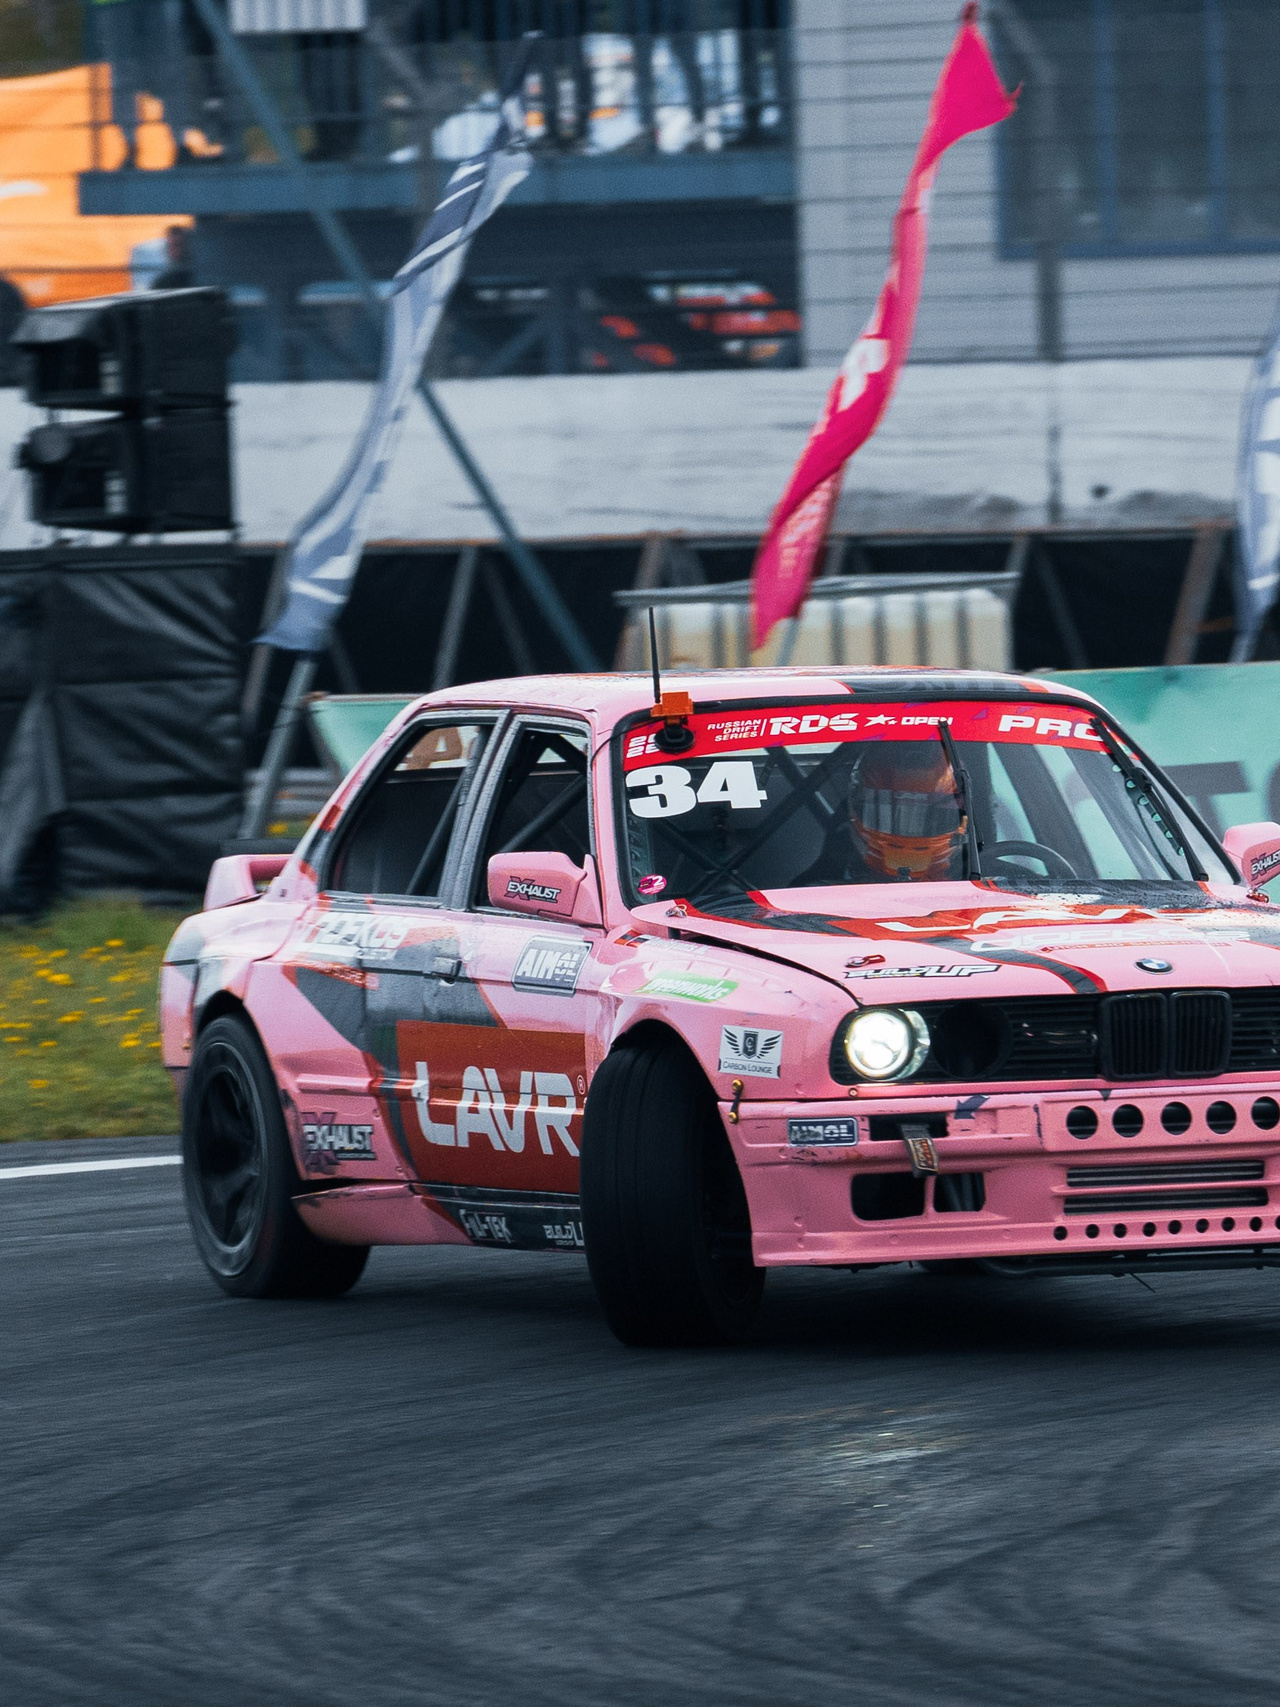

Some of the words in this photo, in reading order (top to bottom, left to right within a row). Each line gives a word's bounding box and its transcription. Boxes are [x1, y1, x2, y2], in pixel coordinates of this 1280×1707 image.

[707, 718, 762, 731] RUSSIAN
[723, 725, 760, 736] DRIFT
[769, 712, 859, 736] RDS
[714, 730, 758, 742] SERIES
[625, 760, 768, 819] 34
[505, 878, 561, 900] EXHAUST
[652, 875, 664, 887] 2
[517, 948, 580, 981] AIMOL
[635, 977, 730, 999] greenworks
[747, 1063, 773, 1075] LOUNGE
[412, 1061, 580, 1157] LAVR
[301, 1117, 374, 1158] EXHAUST
